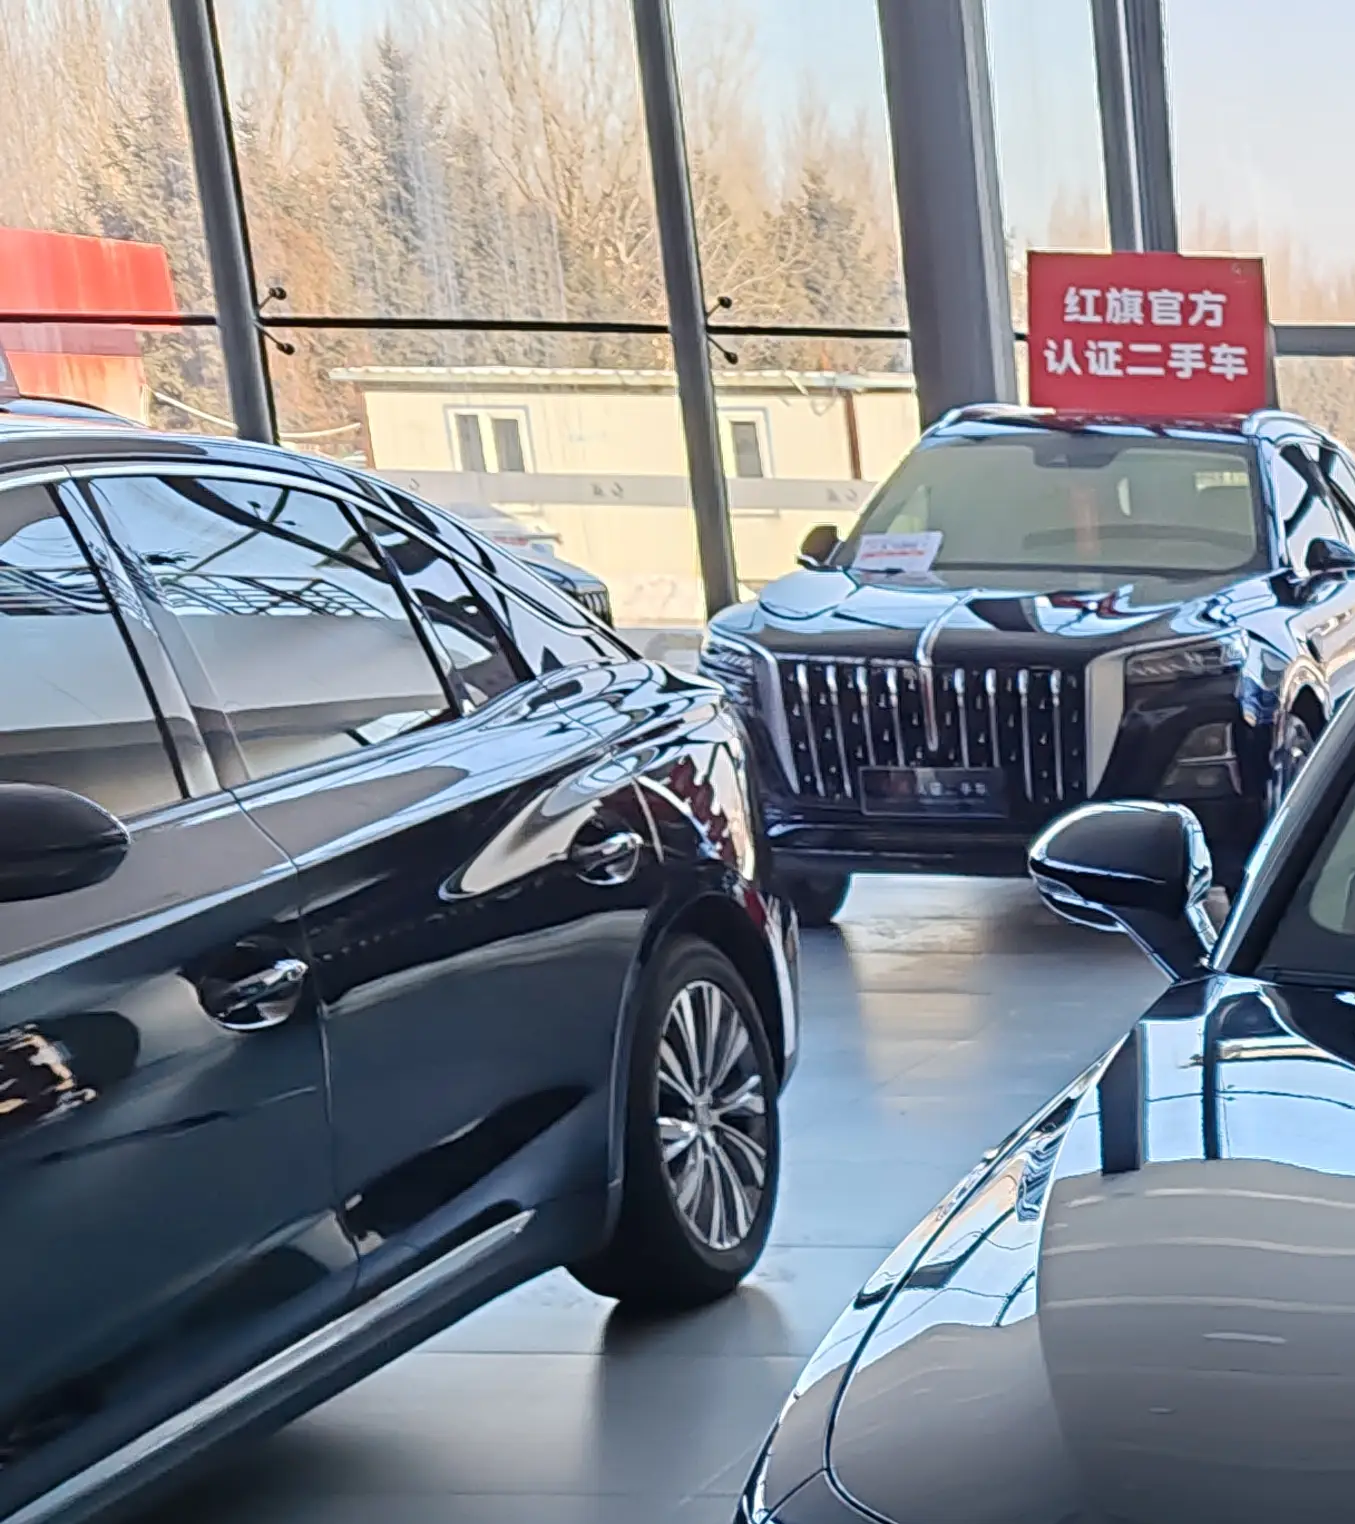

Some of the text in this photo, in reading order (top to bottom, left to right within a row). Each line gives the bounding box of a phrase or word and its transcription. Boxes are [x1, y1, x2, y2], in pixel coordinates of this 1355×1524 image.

[1063, 286, 1228, 328] 红旗官方
[1043, 338, 1249, 382] 认证二手车
